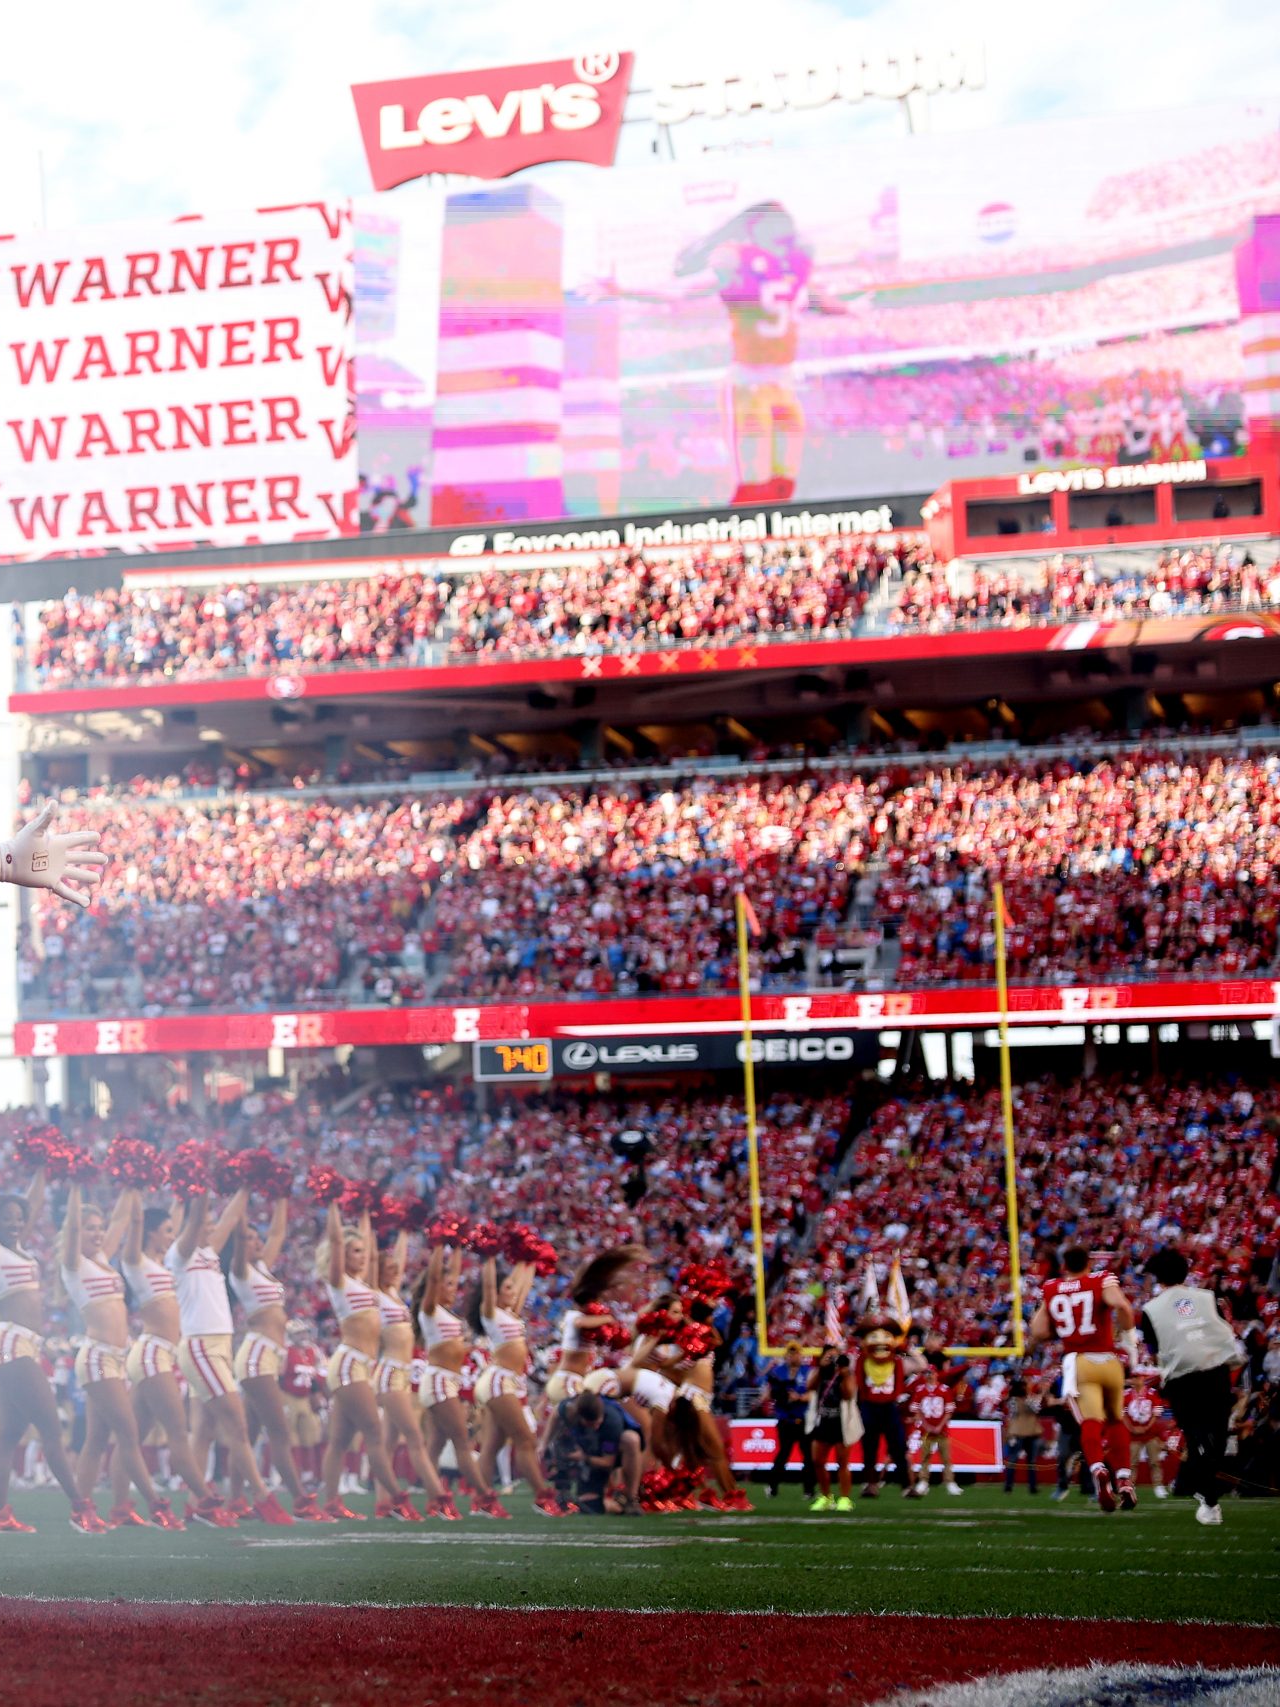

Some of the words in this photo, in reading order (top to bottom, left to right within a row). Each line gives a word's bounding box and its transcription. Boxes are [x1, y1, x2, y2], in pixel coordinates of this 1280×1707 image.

[11, 238, 302, 307] WARNER
[9, 317, 303, 385] WARNER
[6, 397, 307, 463] WARNER
[1105, 460, 1207, 488] STADIUM
[8, 475, 309, 540] WARNER
[493, 529, 620, 554] Foxconn
[624, 513, 766, 545] Industrial
[772, 505, 893, 538] Internet
[599, 1043, 700, 1064] LEXUS
[736, 1036, 854, 1063] GEICO
[1049, 1290, 1097, 1339] 97
